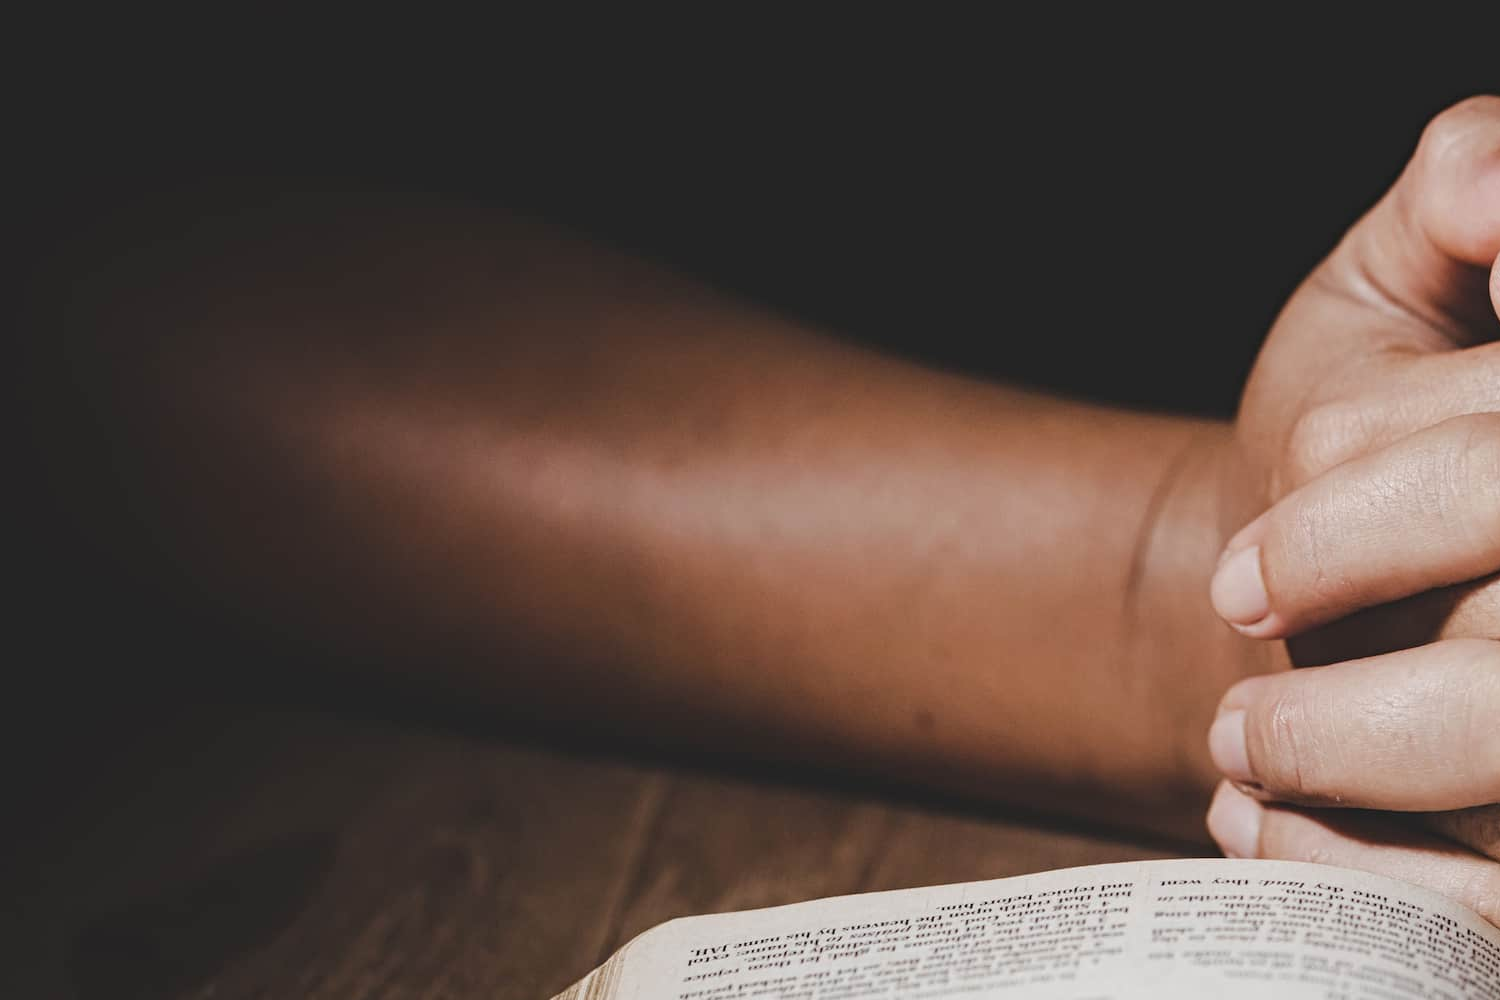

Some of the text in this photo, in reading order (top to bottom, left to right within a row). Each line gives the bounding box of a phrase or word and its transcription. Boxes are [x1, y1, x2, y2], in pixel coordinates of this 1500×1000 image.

[1212, 878, 1248, 886] they
[1316, 883, 1344, 893] dry
[935, 882, 1132, 911] and rejoice before him.
[1353, 890, 1387, 903] into
[1006, 907, 1045, 917] unto
[1052, 902, 1090, 911] Sing
[1074, 906, 1129, 916] before
[1350, 897, 1420, 919] children
[1397, 899, 1424, 912] sea
[690, 890, 1131, 956] him that rideth upon the heavens by his name JAH,
[917, 921, 952, 930] sing
[1425, 919, 1450, 932] the
[1432, 913, 1458, 928] the
[849, 924, 911, 938] praises
[915, 927, 958, 939] them
[965, 924, 985, 932] let
[794, 938, 819, 946] his
[810, 935, 909, 954] exceedingly
[687, 953, 729, 966] extol
